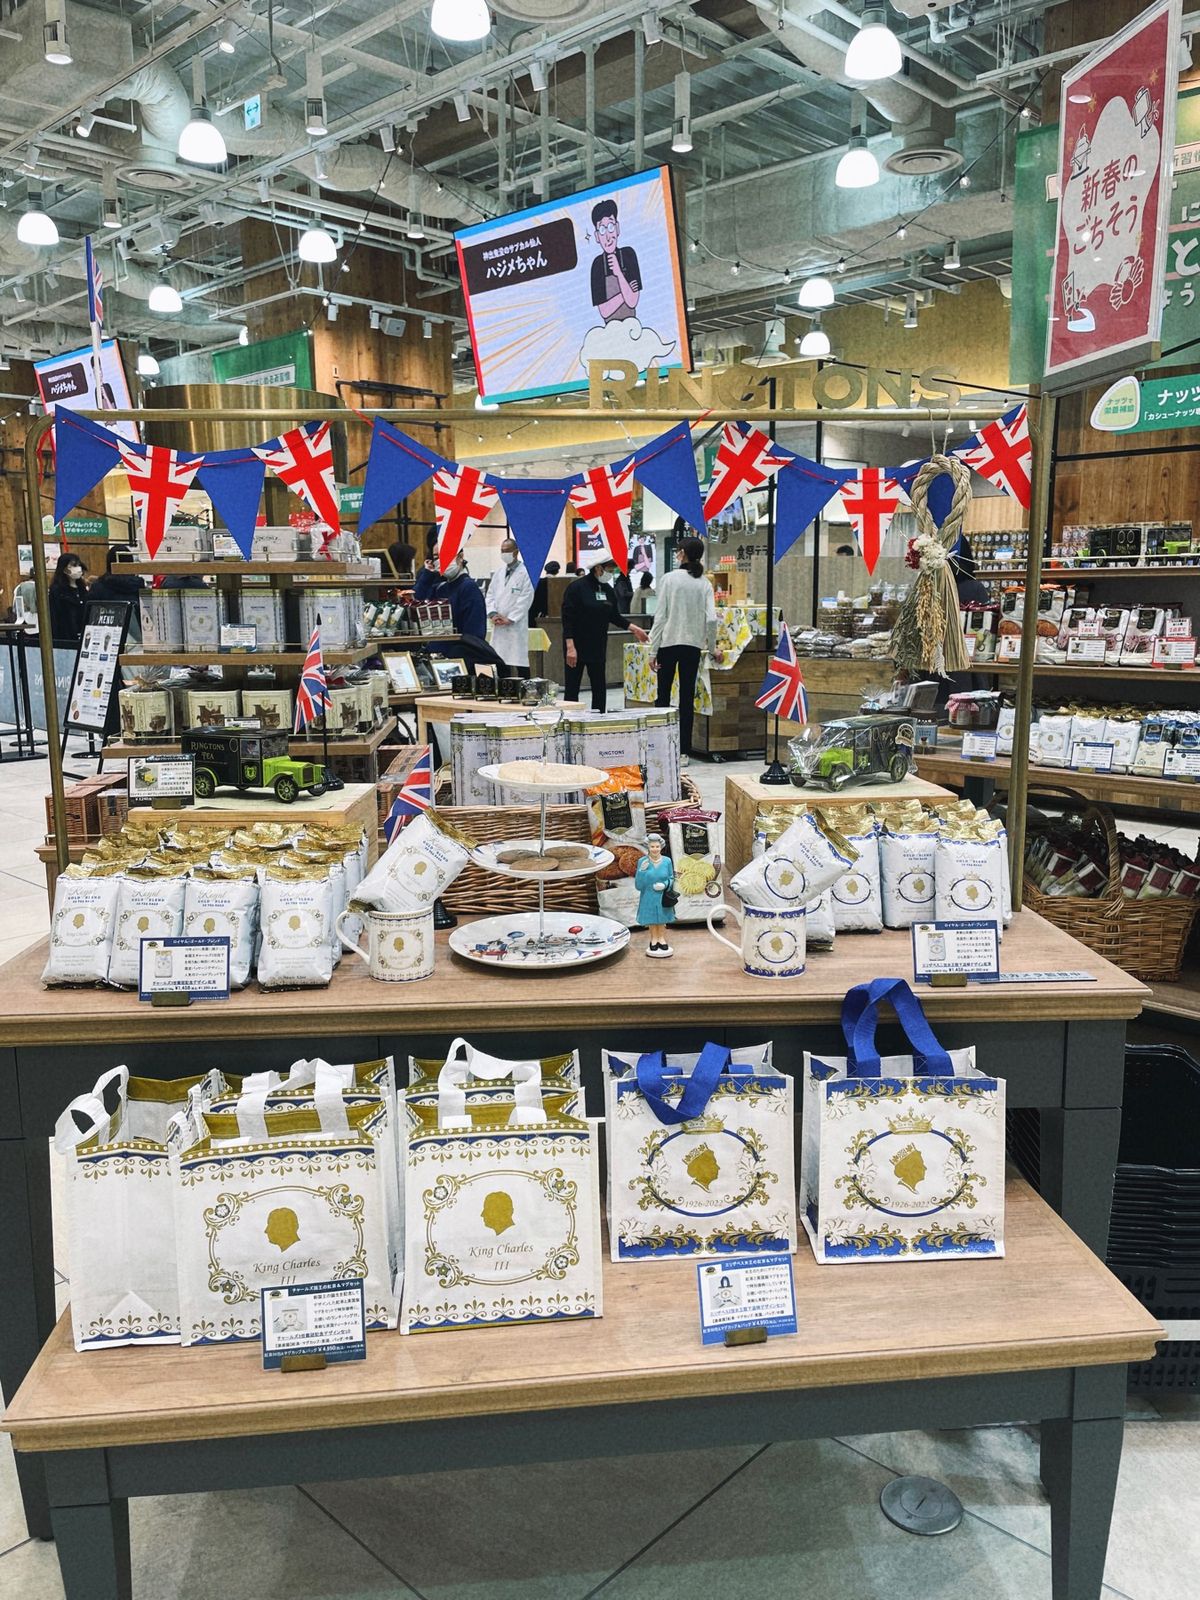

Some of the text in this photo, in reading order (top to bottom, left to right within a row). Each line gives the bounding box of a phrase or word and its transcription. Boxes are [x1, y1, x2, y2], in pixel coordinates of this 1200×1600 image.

[1081, 154, 1138, 212] 新春の
[1073, 195, 1138, 254] ごちそう
[486, 250, 548, 279] ハジメちゃん
[588, 359, 962, 412] RINGTONS
[98, 615, 114, 624] MENU
[190, 742, 224, 750] RINGTONS
[202, 752, 214, 760] TEA
[469, 1242, 534, 1258] King Charles
[253, 1258, 320, 1274] King Charles
[494, 1261, 509, 1271] III
[281, 1276, 296, 1285] III
